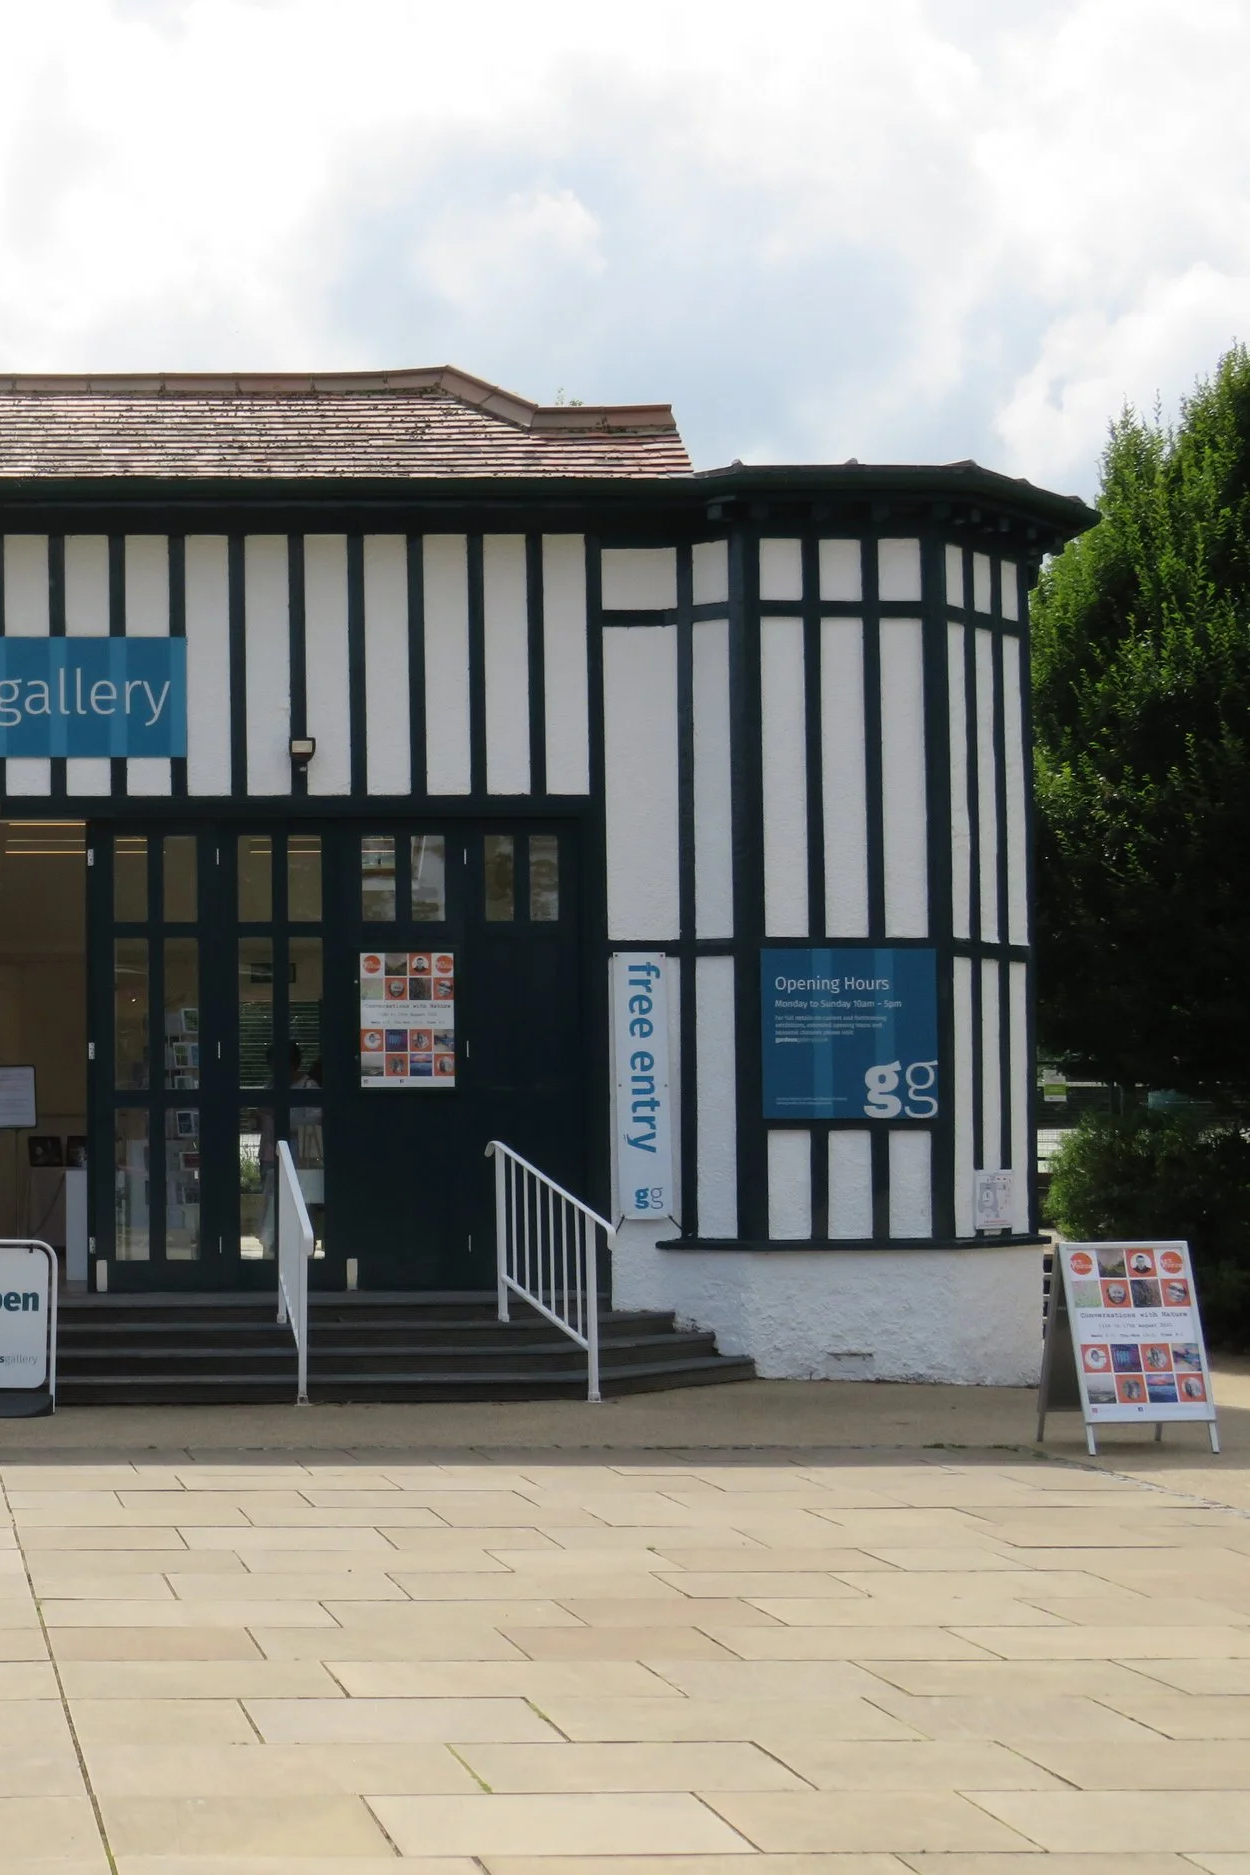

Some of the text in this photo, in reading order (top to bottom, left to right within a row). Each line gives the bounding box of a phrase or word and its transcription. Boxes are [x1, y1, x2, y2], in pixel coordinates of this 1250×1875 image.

[775, 975, 890, 993] Opening Hours
[775, 999, 808, 1009] Monday
[810, 1000, 818, 1008] to
[820, 999, 851, 1009] Sunday
[853, 1000, 875, 1008] 10am
[884, 1000, 902, 1009] 5pm
[627, 961, 661, 1154] free entry
[863, 1059, 939, 1118] gg
[1140, 1311, 1158, 1319] with
